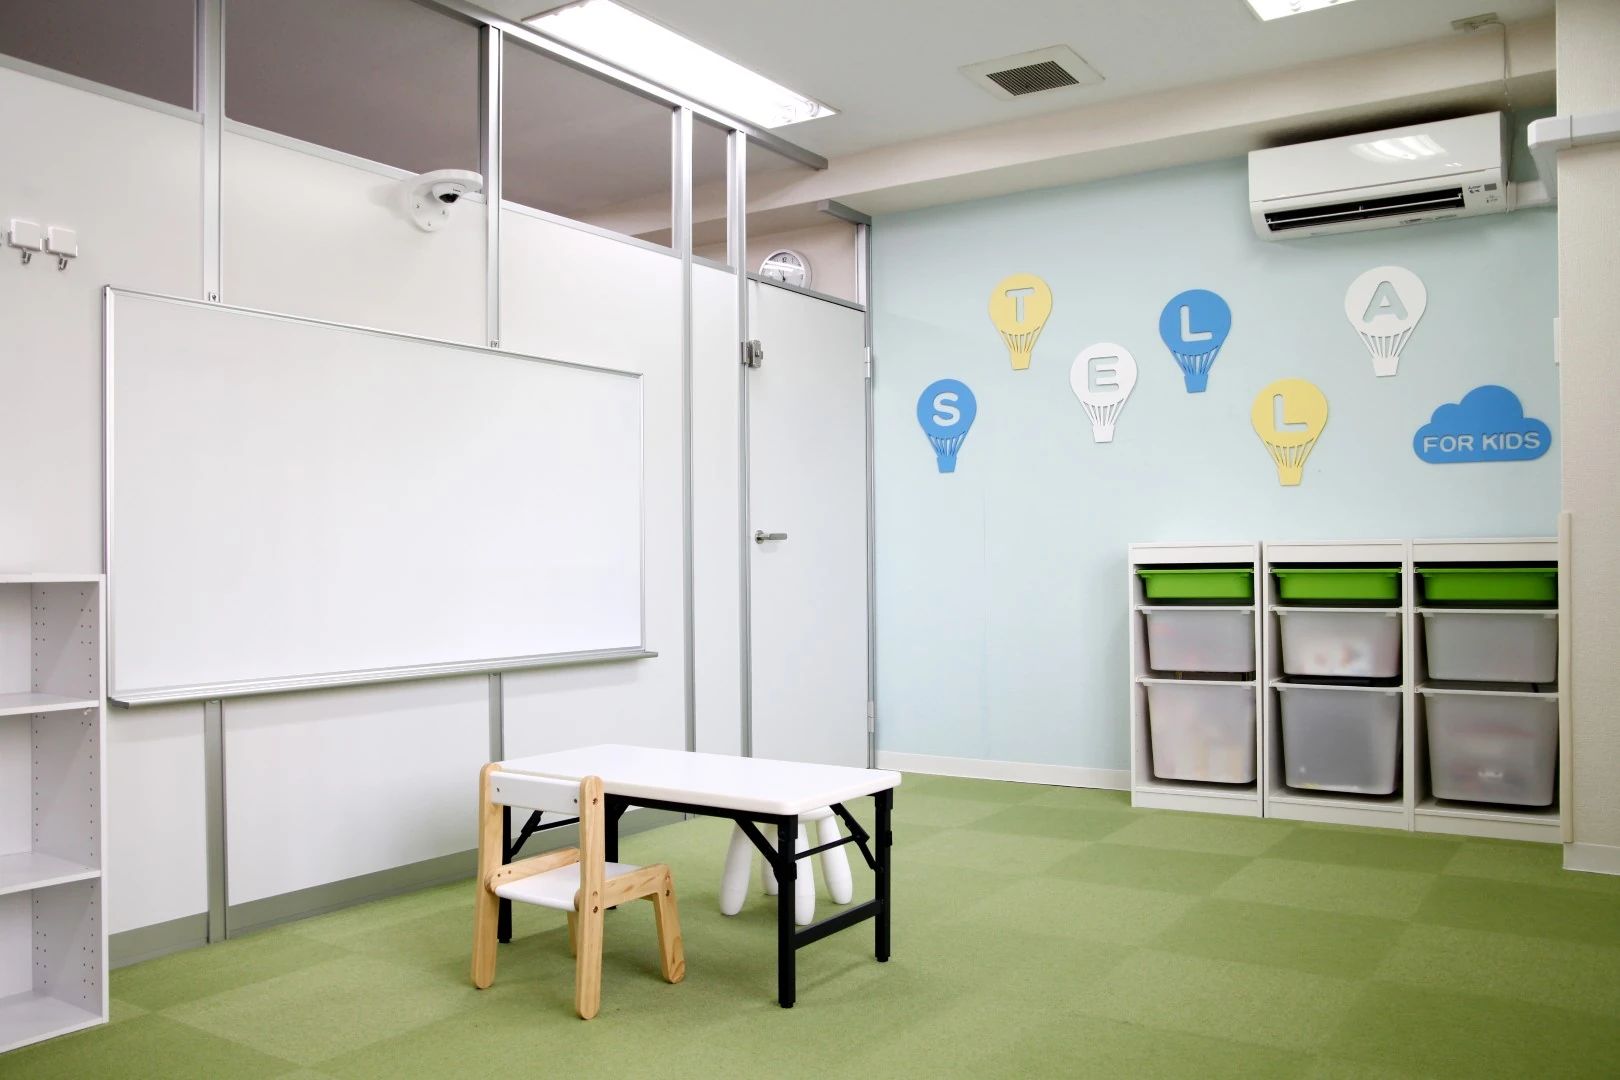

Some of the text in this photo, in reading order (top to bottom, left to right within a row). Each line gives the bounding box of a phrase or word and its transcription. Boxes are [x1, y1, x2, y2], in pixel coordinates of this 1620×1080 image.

[1005, 287, 1035, 323] T
[1362, 280, 1409, 323] A
[1179, 304, 1213, 342] L
[1088, 355, 1119, 393] E
[932, 391, 961, 427] S
[1272, 393, 1309, 433] L
[1423, 431, 1541, 453] FOR KIDS
